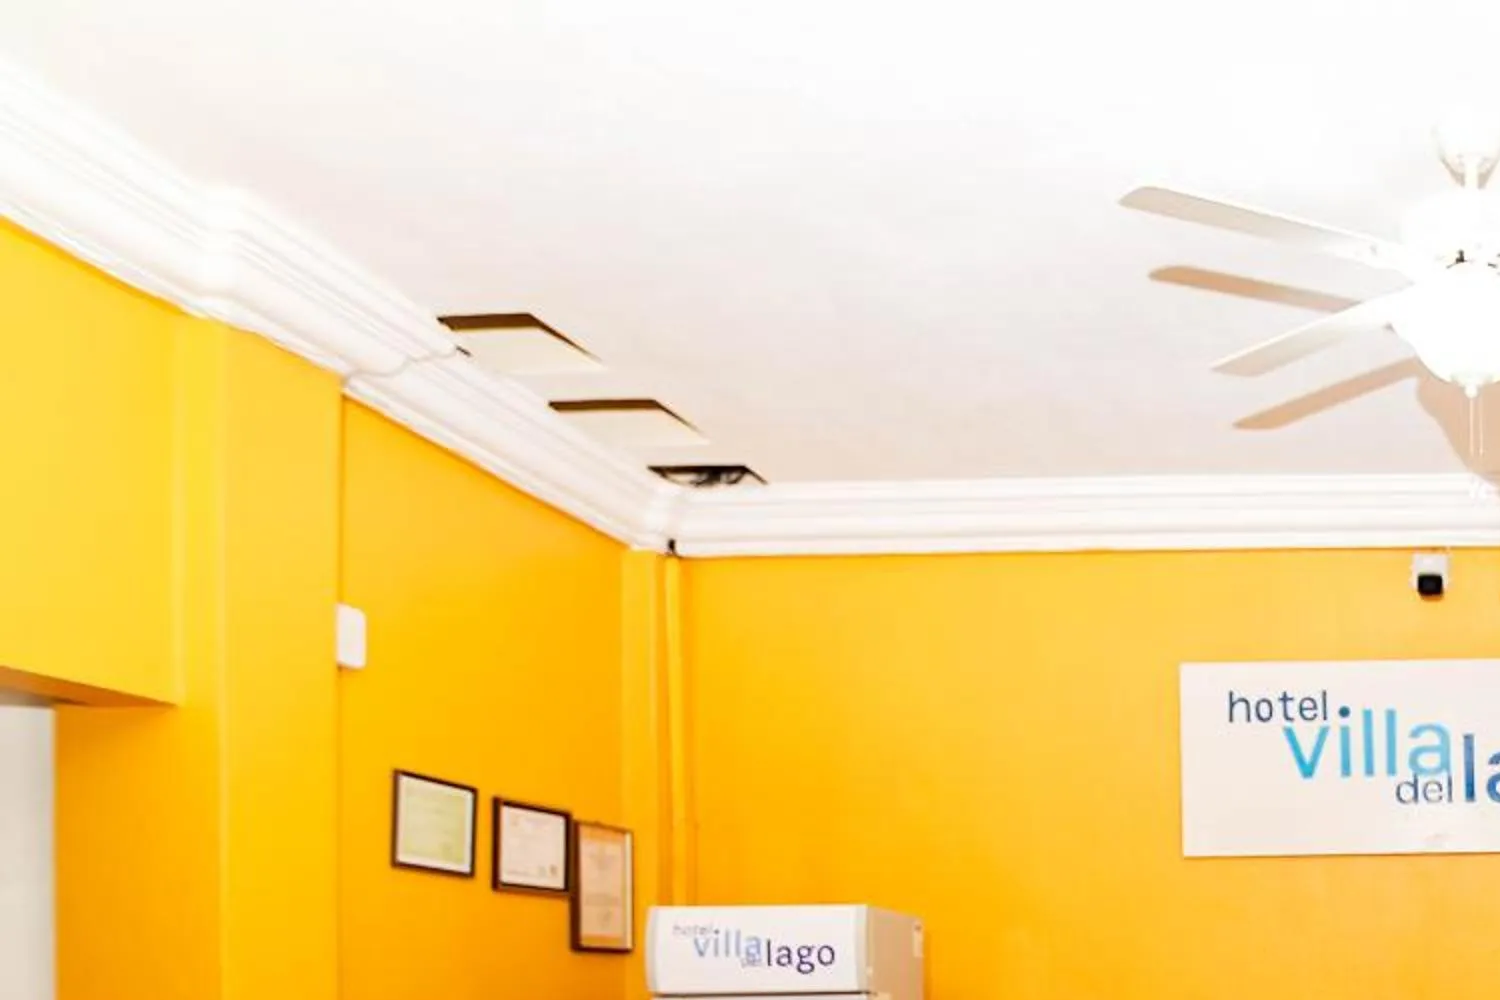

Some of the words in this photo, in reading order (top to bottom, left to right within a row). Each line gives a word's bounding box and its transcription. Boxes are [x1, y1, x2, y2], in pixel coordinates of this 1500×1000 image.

[1228, 690, 1329, 724] hotel
[1282, 706, 1452, 779] villa
[1396, 776, 1453, 804] del
[693, 929, 762, 957] villa
[766, 938, 836, 975] lago
